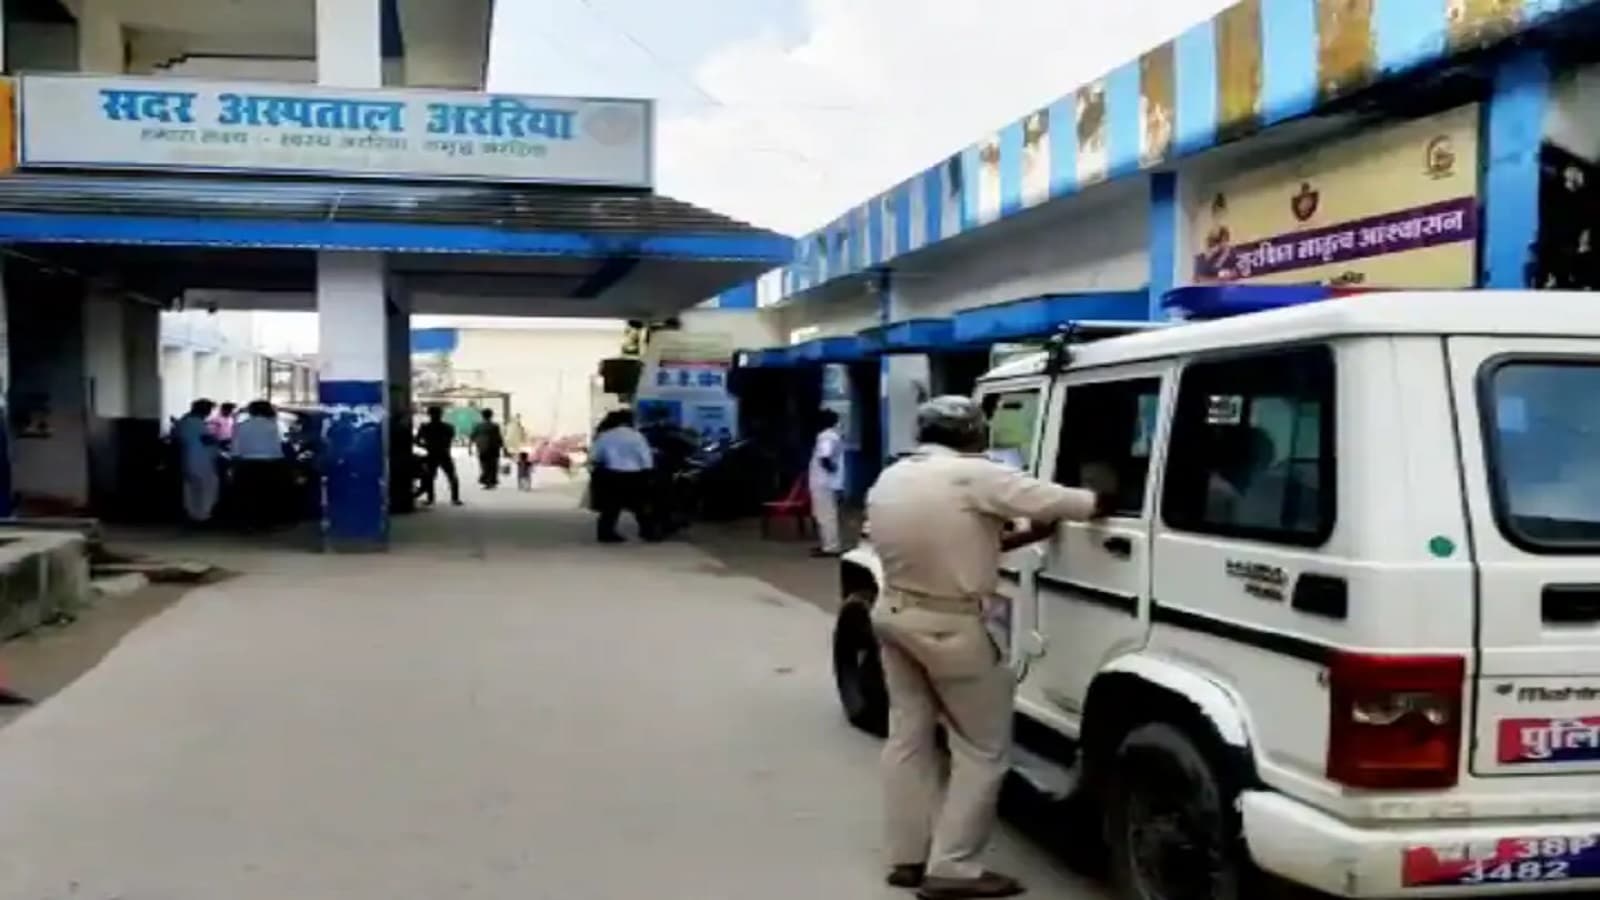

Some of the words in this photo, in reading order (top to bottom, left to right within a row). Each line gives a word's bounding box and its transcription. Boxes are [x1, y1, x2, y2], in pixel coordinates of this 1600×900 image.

[99, 88, 197, 123] सदर
[218, 92, 405, 132] अस्पताल
[427, 93, 578, 140] अररिया
[1236, 241, 1294, 278] सुरक्षित
[1297, 230, 1355, 263] मातृत्व
[1358, 210, 1464, 247] आश्वासन
[1460, 859, 1569, 885] 3482
